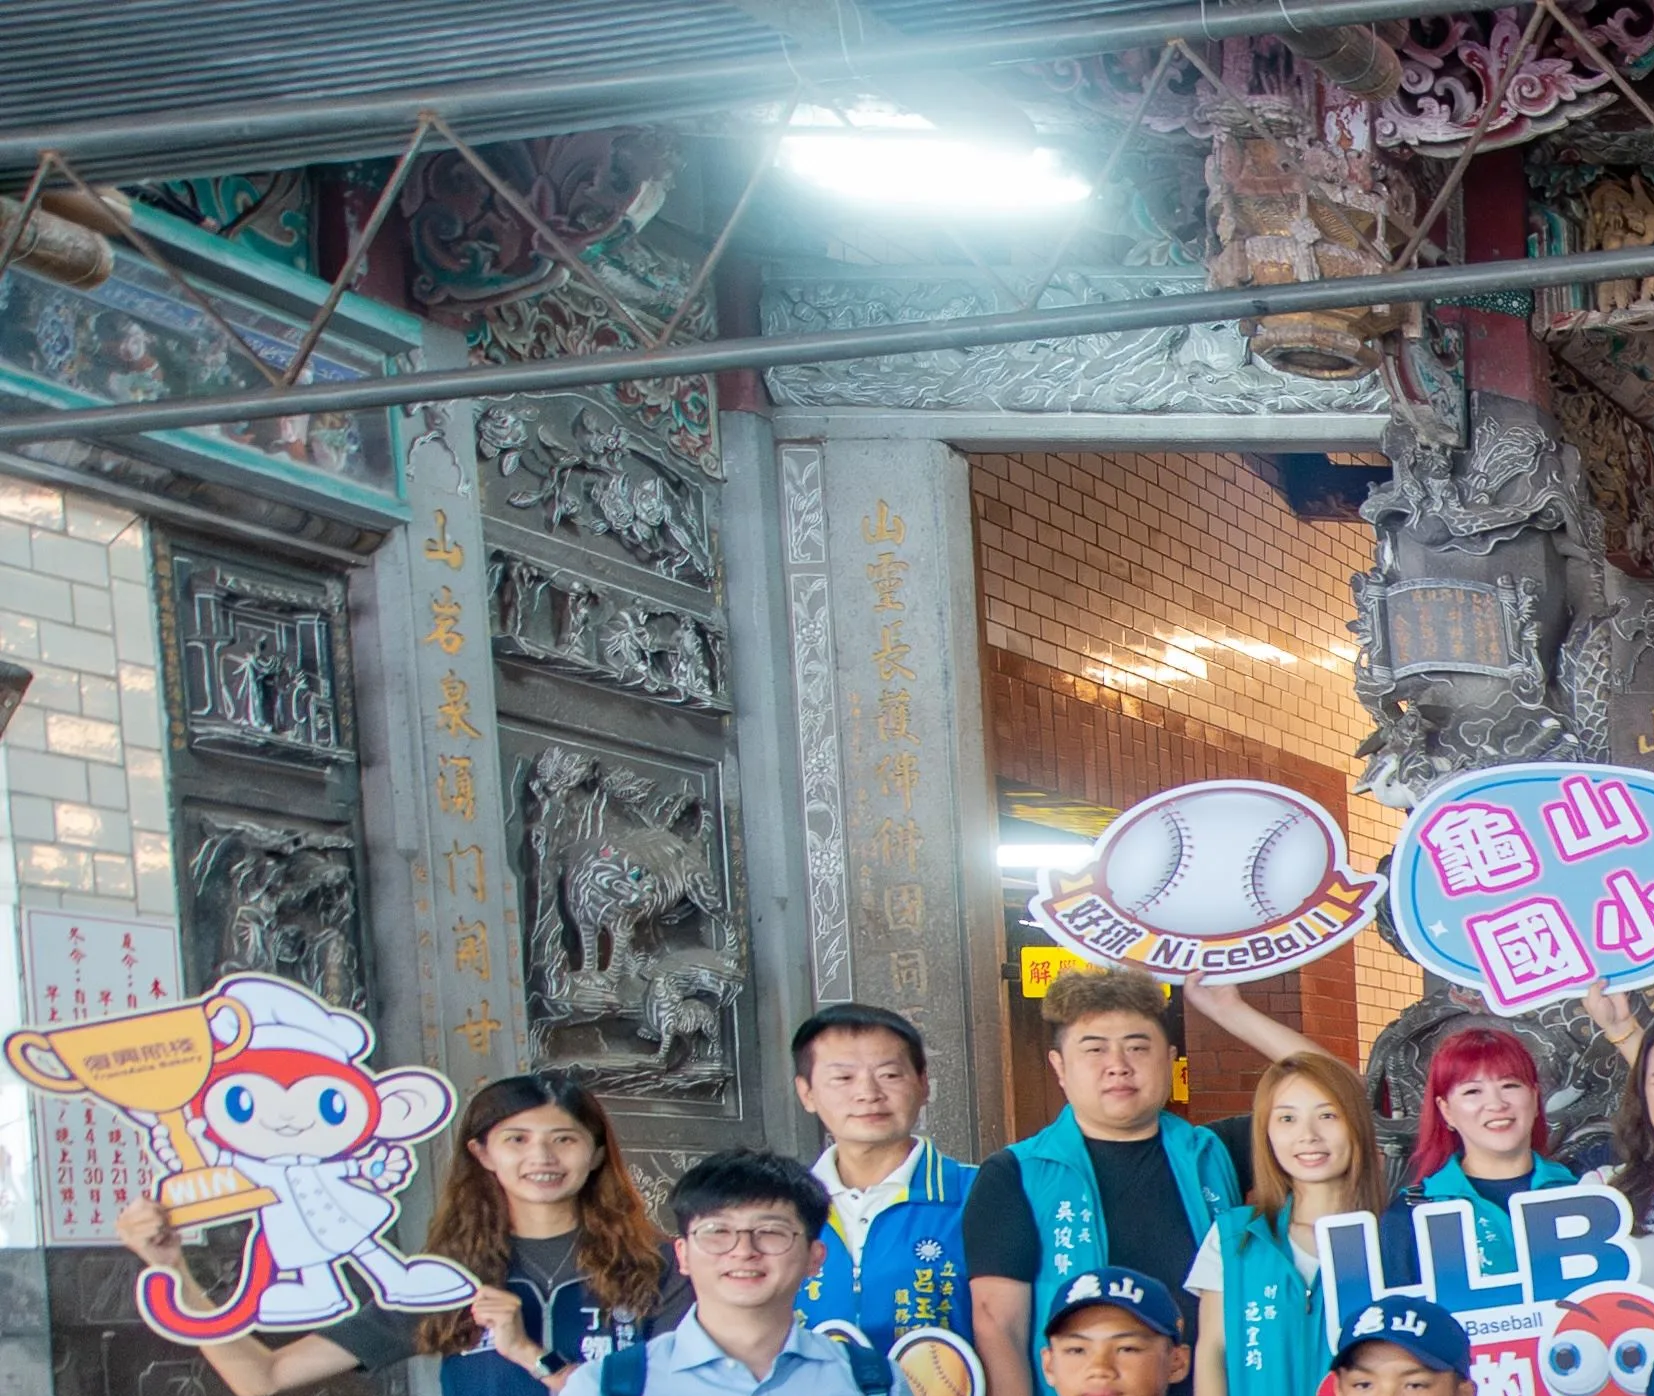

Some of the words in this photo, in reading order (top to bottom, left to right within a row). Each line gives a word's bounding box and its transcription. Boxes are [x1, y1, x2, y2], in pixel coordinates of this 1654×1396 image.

[1433, 782, 1646, 894] 龜山
[1061, 898, 1144, 956] 好球
[1151, 910, 1339, 968] NiceBall
[168, 1167, 237, 1201] WIN
[1327, 1195, 1630, 1330] LLB
[914, 1268, 936, 1332] 呂玉
